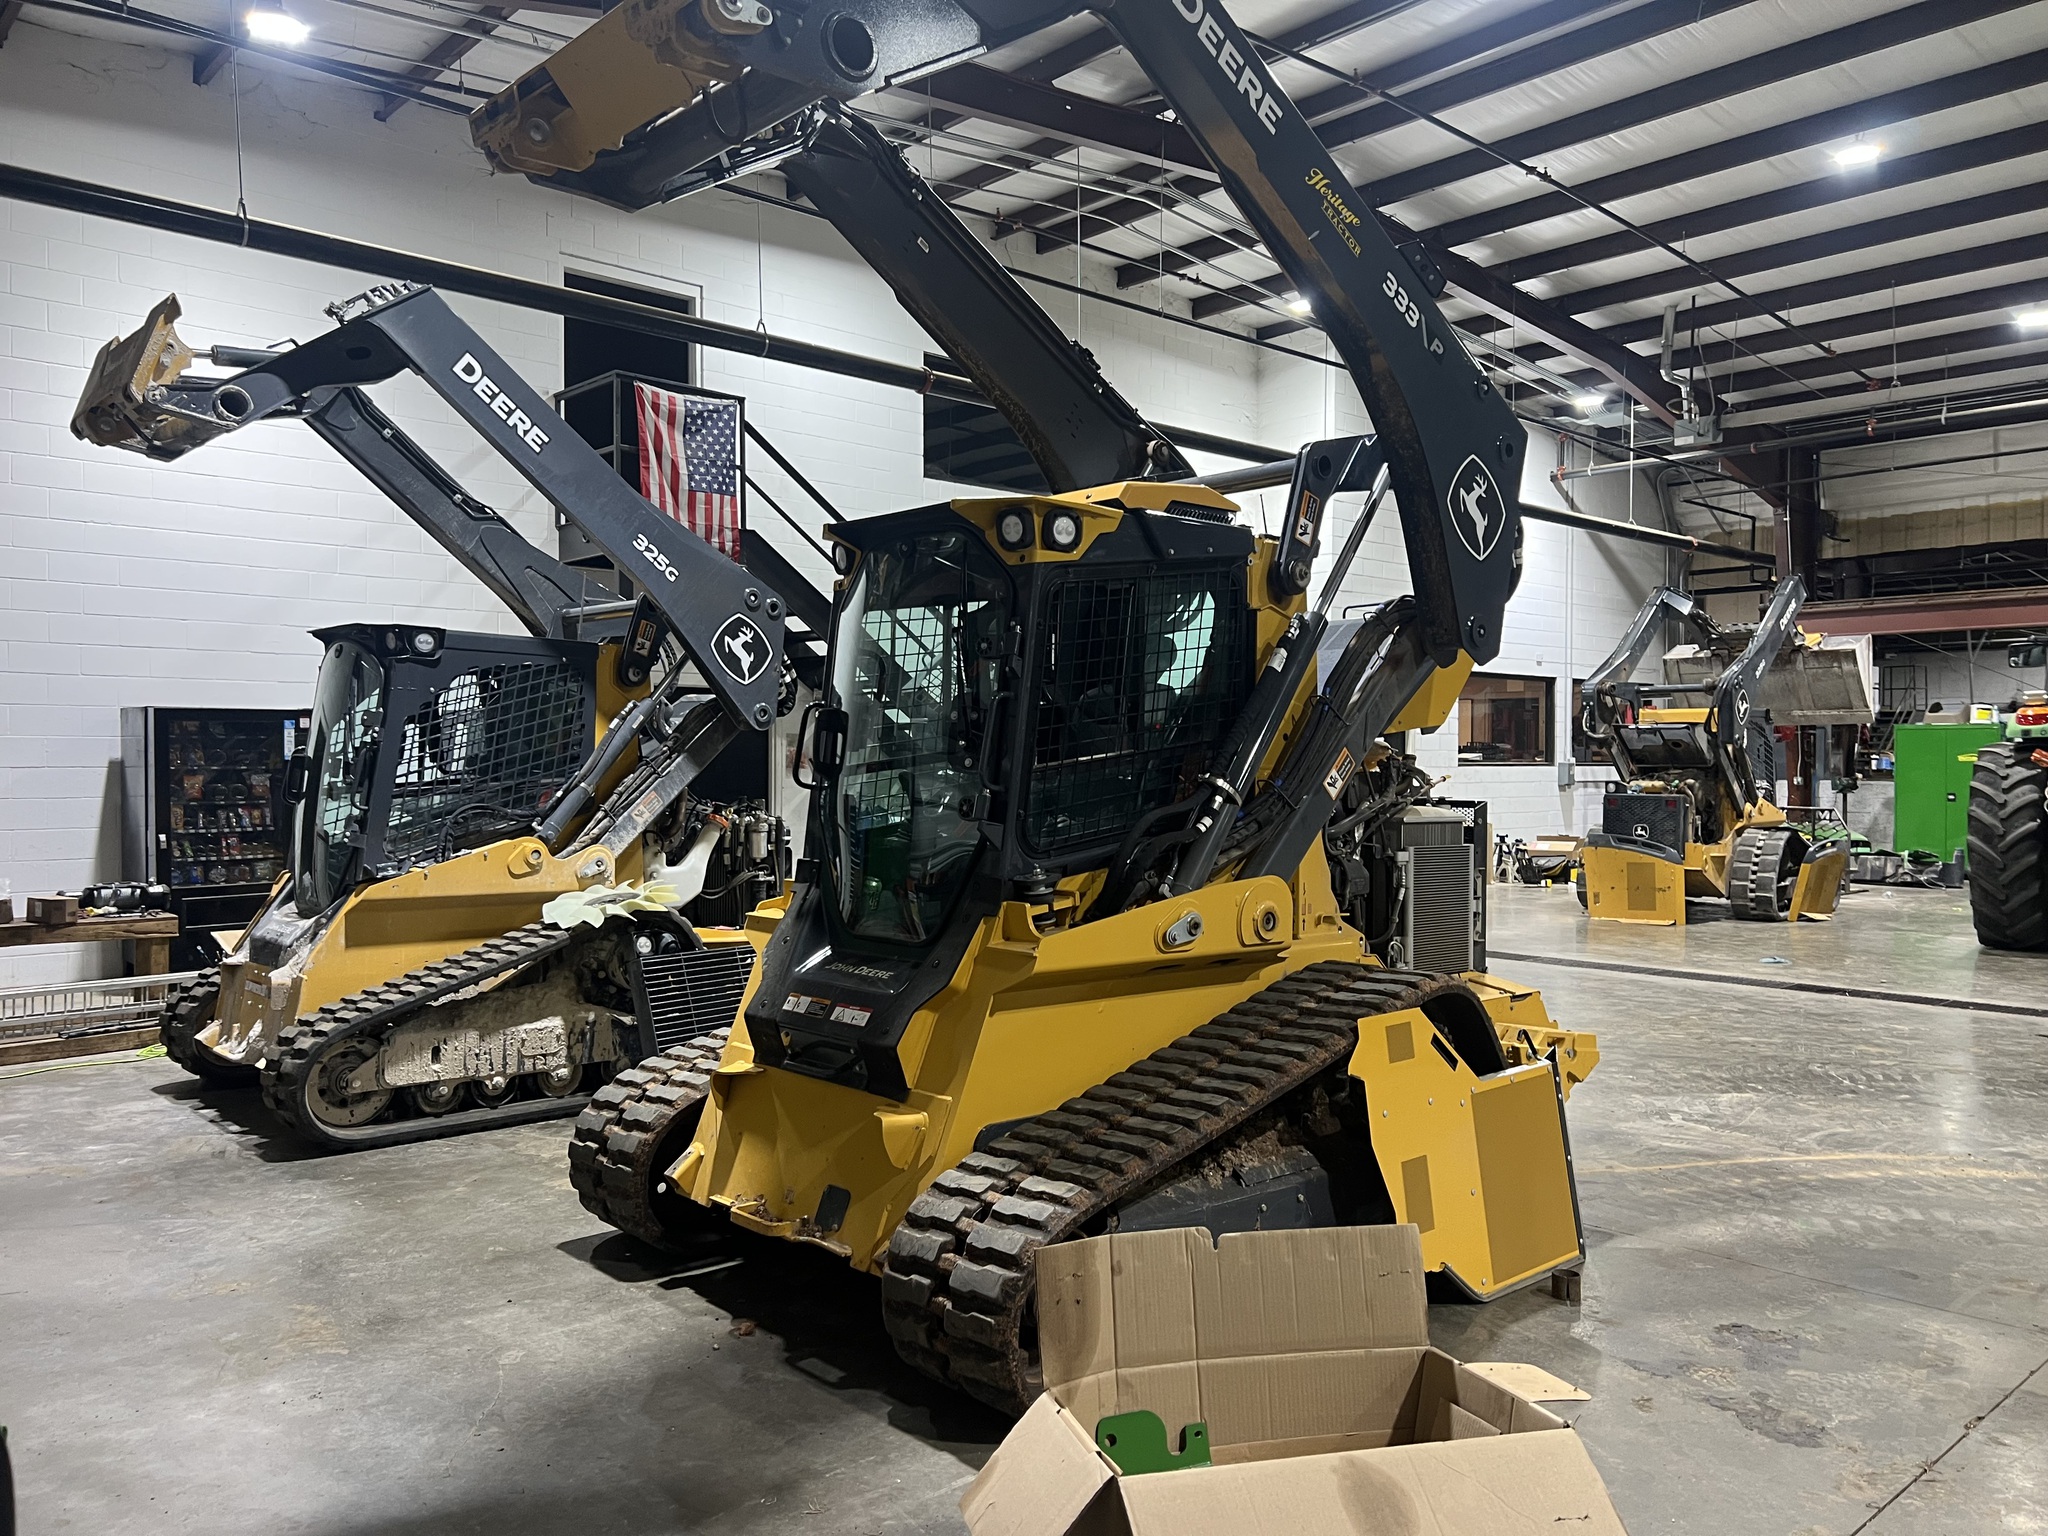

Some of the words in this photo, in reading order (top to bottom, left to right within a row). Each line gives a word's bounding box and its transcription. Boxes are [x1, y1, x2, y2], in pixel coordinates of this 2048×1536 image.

[1304, 167, 1361, 227] Heritage
[1321, 200, 1362, 257] TRACTOR
[452, 352, 550, 453] DEERE
[632, 533, 680, 582] 325G
[824, 961, 857, 973] JOHN
[855, 966, 895, 979] DEERE
